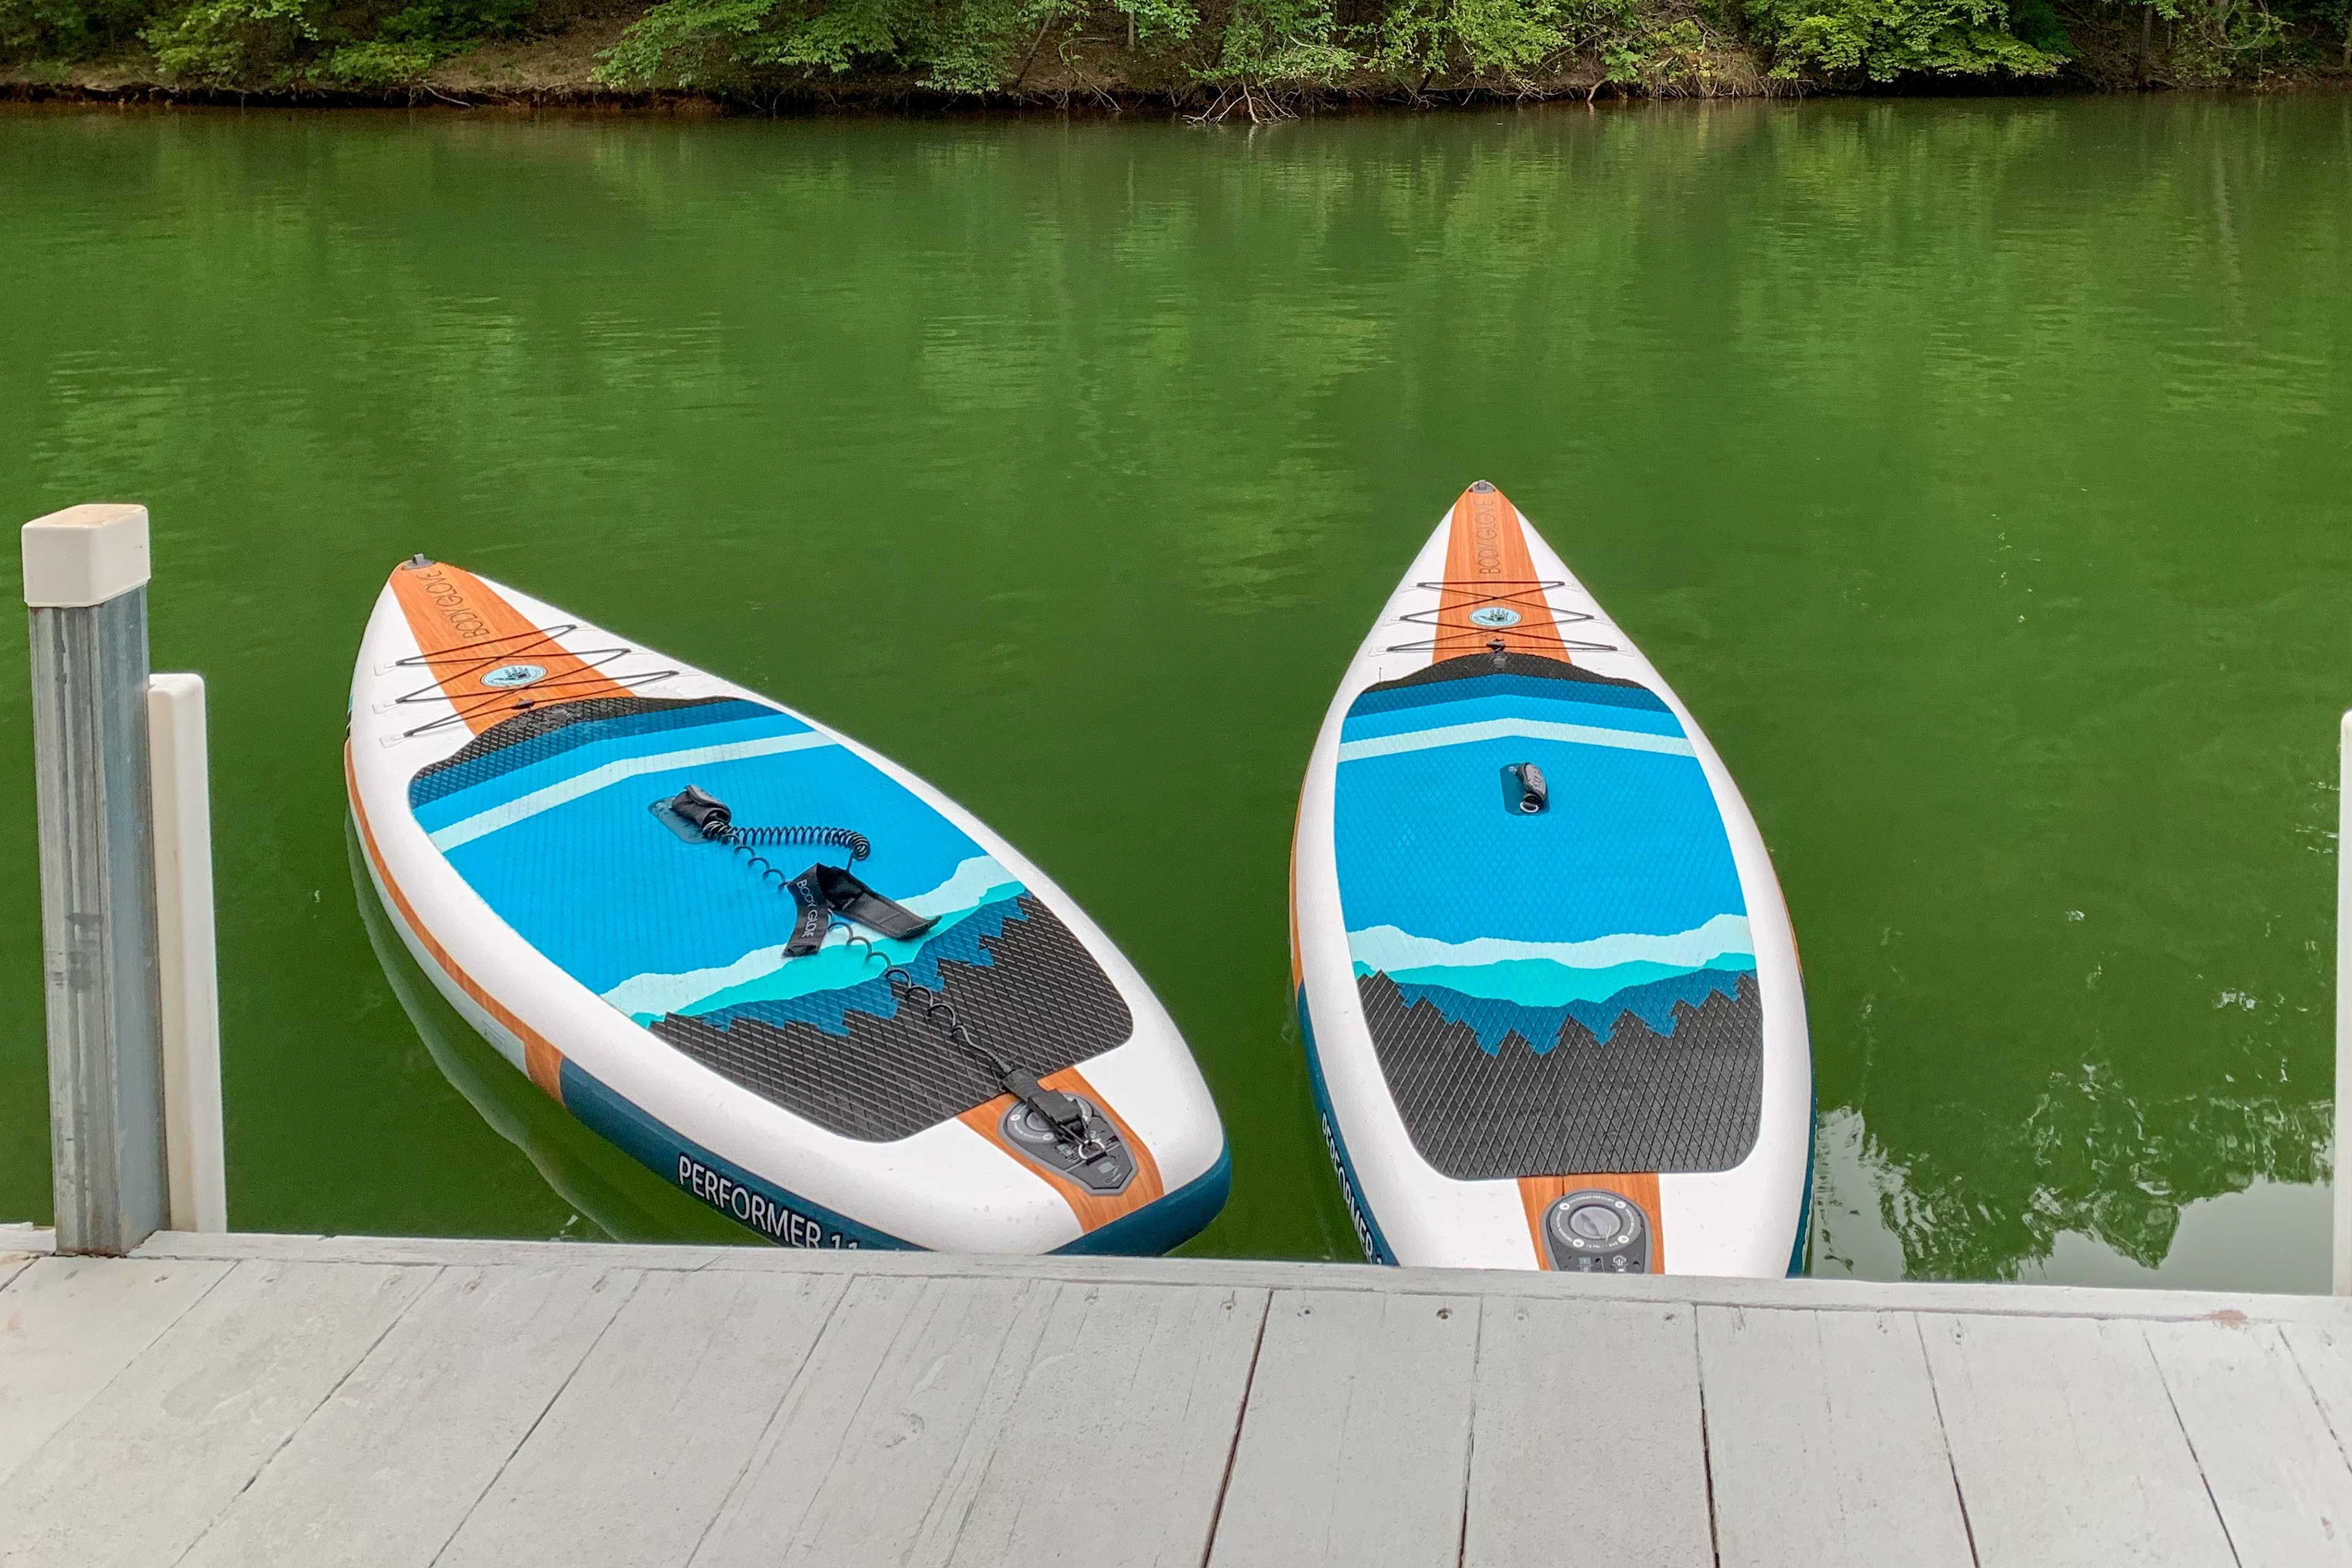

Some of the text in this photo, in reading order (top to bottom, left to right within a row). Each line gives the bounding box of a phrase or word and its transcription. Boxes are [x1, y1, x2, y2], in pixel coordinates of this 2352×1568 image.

[1474, 500, 1501, 574] BODY GLOVE
[417, 570, 490, 638] BODY GLOVE
[796, 878, 817, 907] BODY
[679, 1155, 858, 1250] PERFORMER 1
